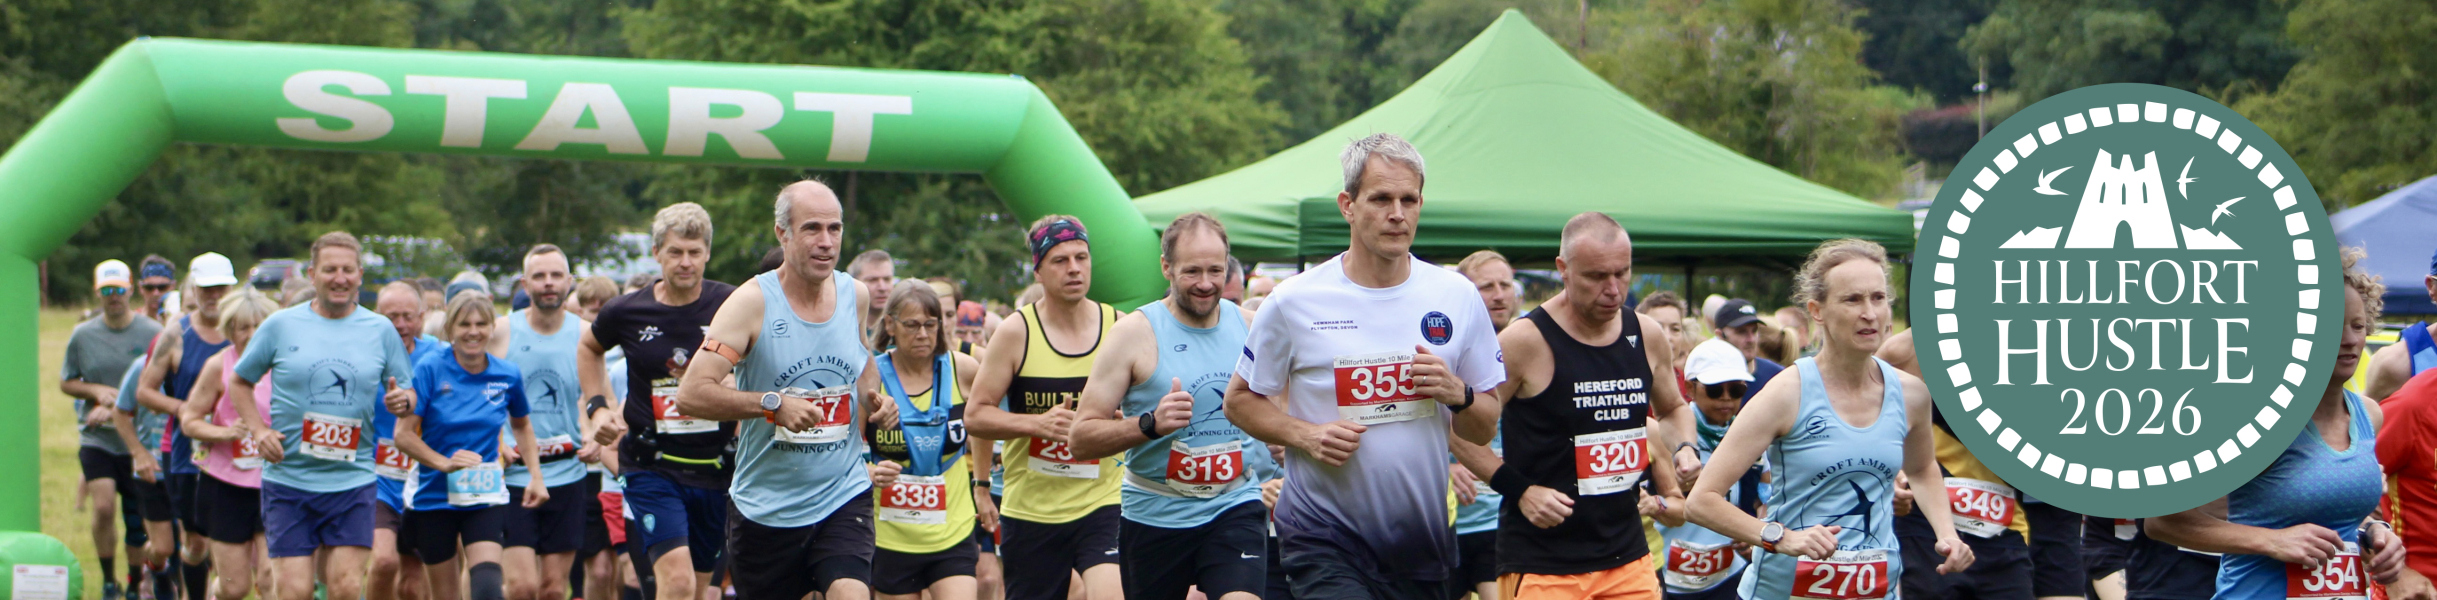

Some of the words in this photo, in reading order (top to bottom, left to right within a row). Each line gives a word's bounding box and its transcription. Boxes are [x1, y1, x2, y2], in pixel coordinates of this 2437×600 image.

[275, 70, 913, 163] START
[1427, 316, 1446, 328] HOPE
[773, 356, 812, 388] CROFT
[1340, 358, 1363, 366] Hillfort
[1364, 357, 1386, 365] Hustle
[1188, 373, 1211, 394] CROFT
[1350, 363, 1417, 401] 355
[1574, 378, 1643, 394] HEREFORD
[1573, 392, 1647, 408] TRIATHLON
[1594, 408, 1630, 421] CLUB
[311, 421, 352, 447] 203
[876, 429, 906, 445] BUIL
[385, 446, 408, 467] 21
[772, 441, 824, 453] RUNNING
[1039, 439, 1073, 460] 23
[1589, 440, 1640, 474] 320
[1177, 454, 1234, 481] 313
[1810, 457, 1854, 487] CROFT
[456, 470, 495, 491] 448
[891, 483, 939, 508] 338
[1953, 487, 2006, 520] 349
[1678, 549, 1723, 573] 251
[1807, 563, 1876, 596] 270
[2302, 556, 2359, 592] 354
